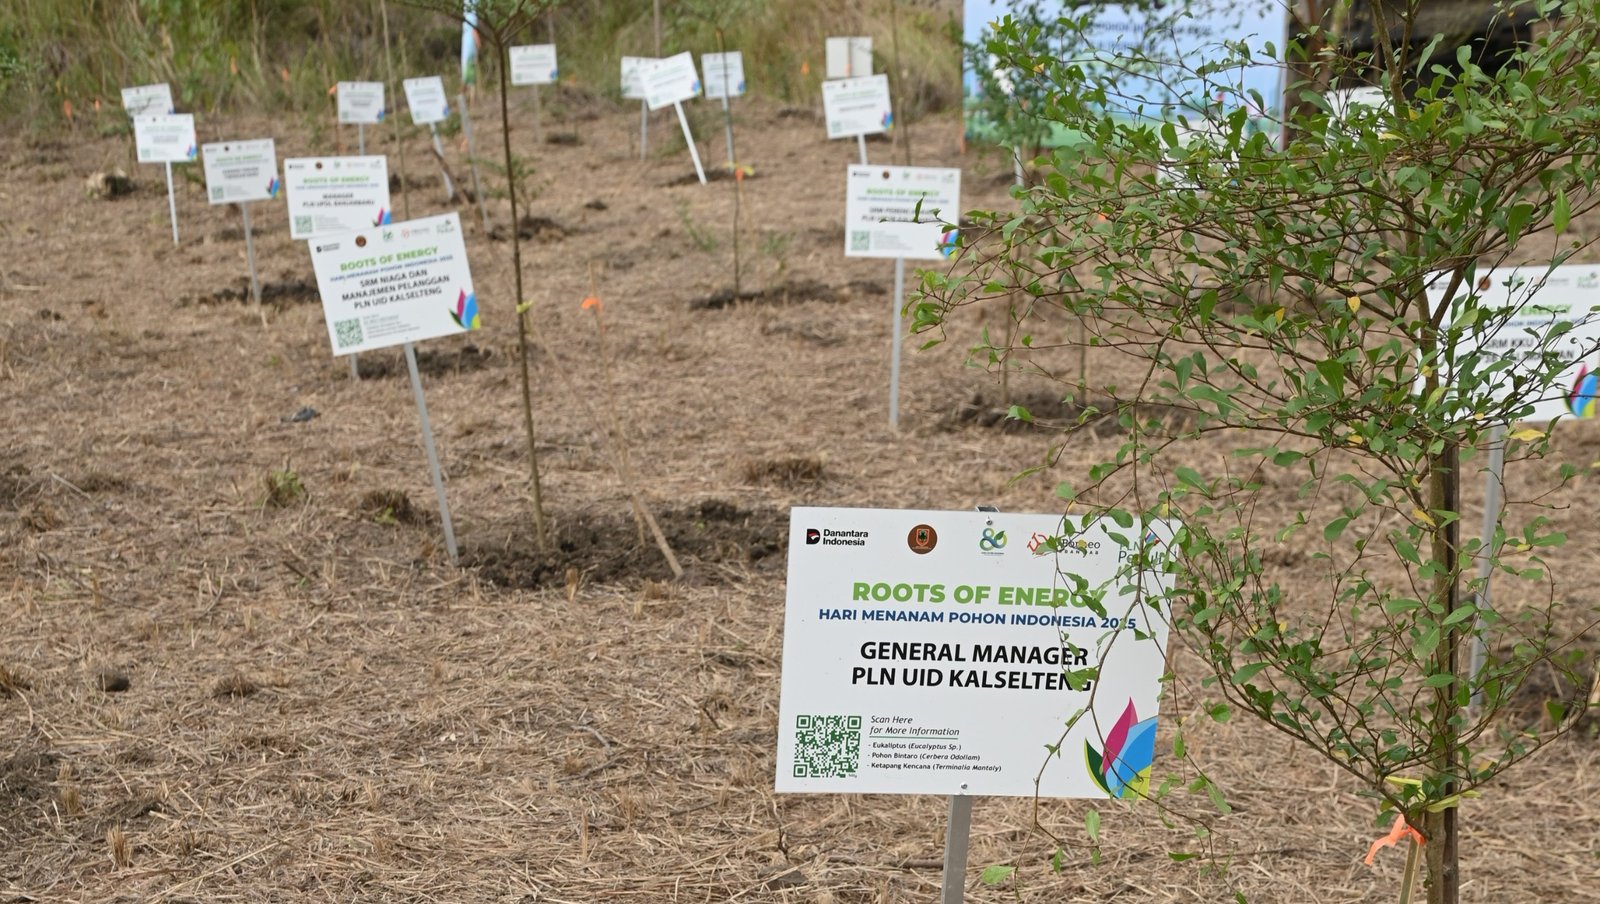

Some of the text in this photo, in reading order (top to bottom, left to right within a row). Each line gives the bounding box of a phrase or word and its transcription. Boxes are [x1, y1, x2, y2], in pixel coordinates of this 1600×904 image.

[340, 246, 438, 272] ROOTS OF ENERGY
[360, 269, 428, 287] SRM NIAGA DAN
[342, 275, 450, 301] MANAJEMEN PELANGGAN
[354, 286, 442, 310] PLN UID KALSELTENG
[823, 538, 865, 546] Indonesia
[824, 528, 868, 538] Danantara
[853, 582, 946, 602] ROOTS
[954, 584, 991, 604] OF
[819, 608, 1136, 629] HARI MENANAM POHON INDONESIA 205
[860, 642, 1088, 666] GENERAL MANAGER
[852, 667, 896, 685] PLN
[902, 668, 944, 686] UID
[870, 716, 913, 724] Scan Here
[870, 726, 882, 735] for
[909, 727, 960, 736] Information
[872, 742, 906, 750] Eukaliptus
[908, 742, 947, 751] (Eucalyptus
[871, 762, 902, 770] Ketapang
[932, 763, 970, 771] (Terminalia
[972, 764, 1002, 772] Mantaly)
